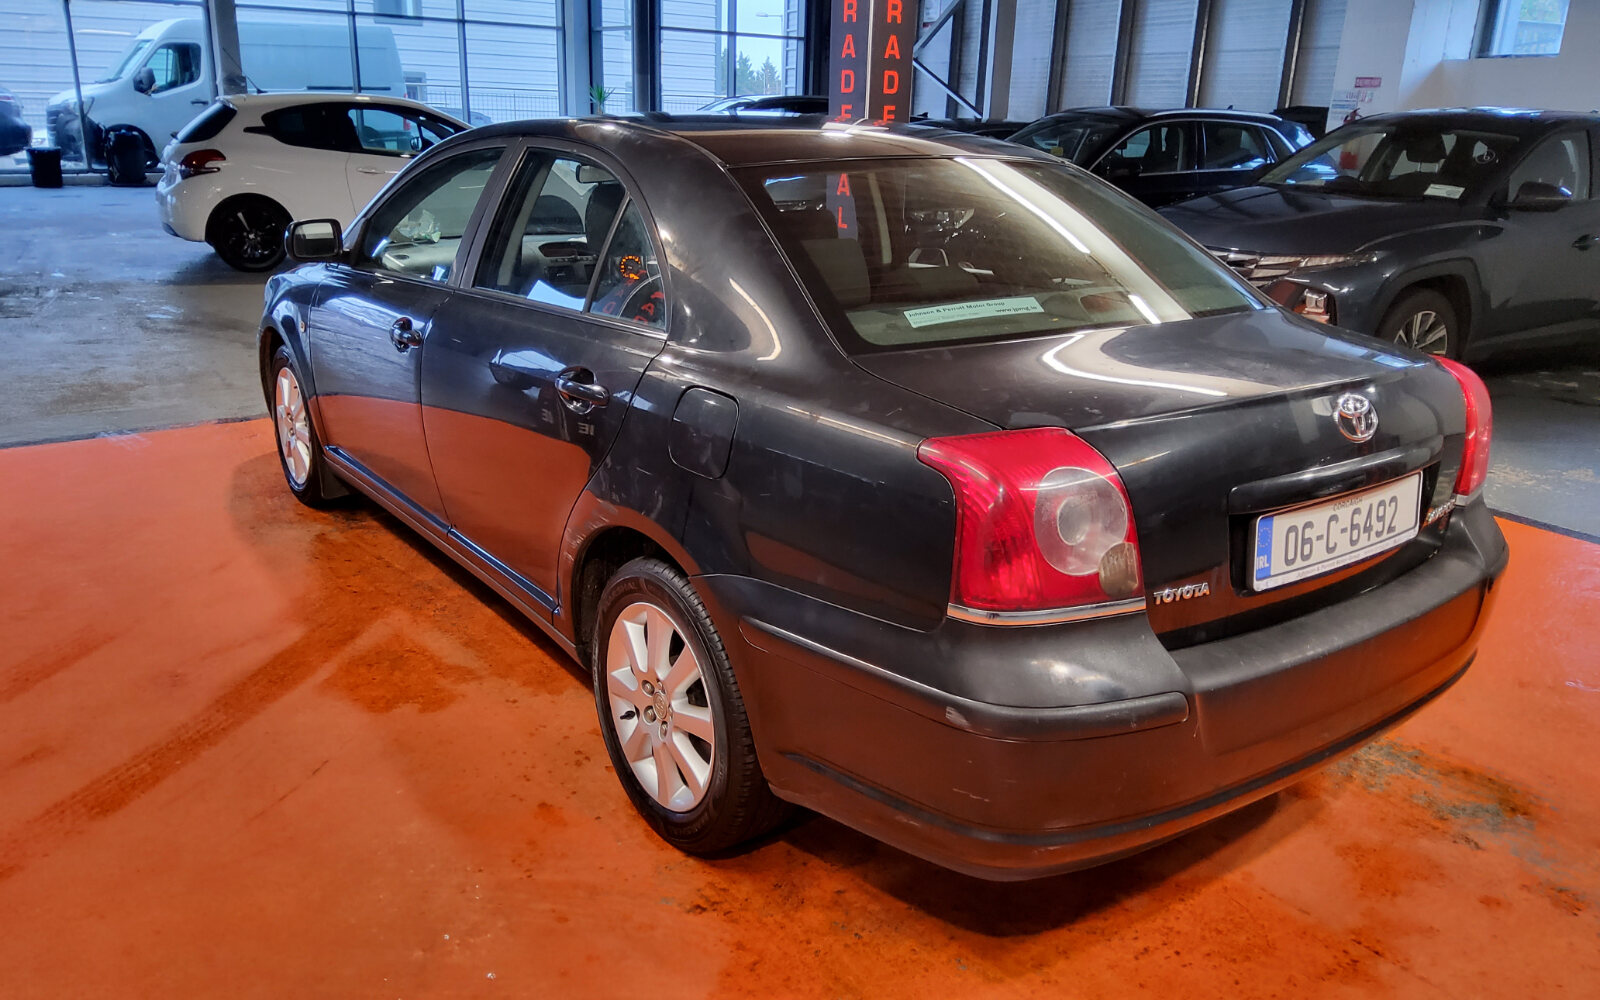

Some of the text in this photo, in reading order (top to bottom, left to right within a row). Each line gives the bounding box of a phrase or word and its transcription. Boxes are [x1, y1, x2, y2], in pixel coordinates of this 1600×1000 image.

[1284, 496, 1398, 567] 06-C-6492
[1256, 555, 1270, 570] IRL
[1154, 582, 1210, 605] TOYOTA
